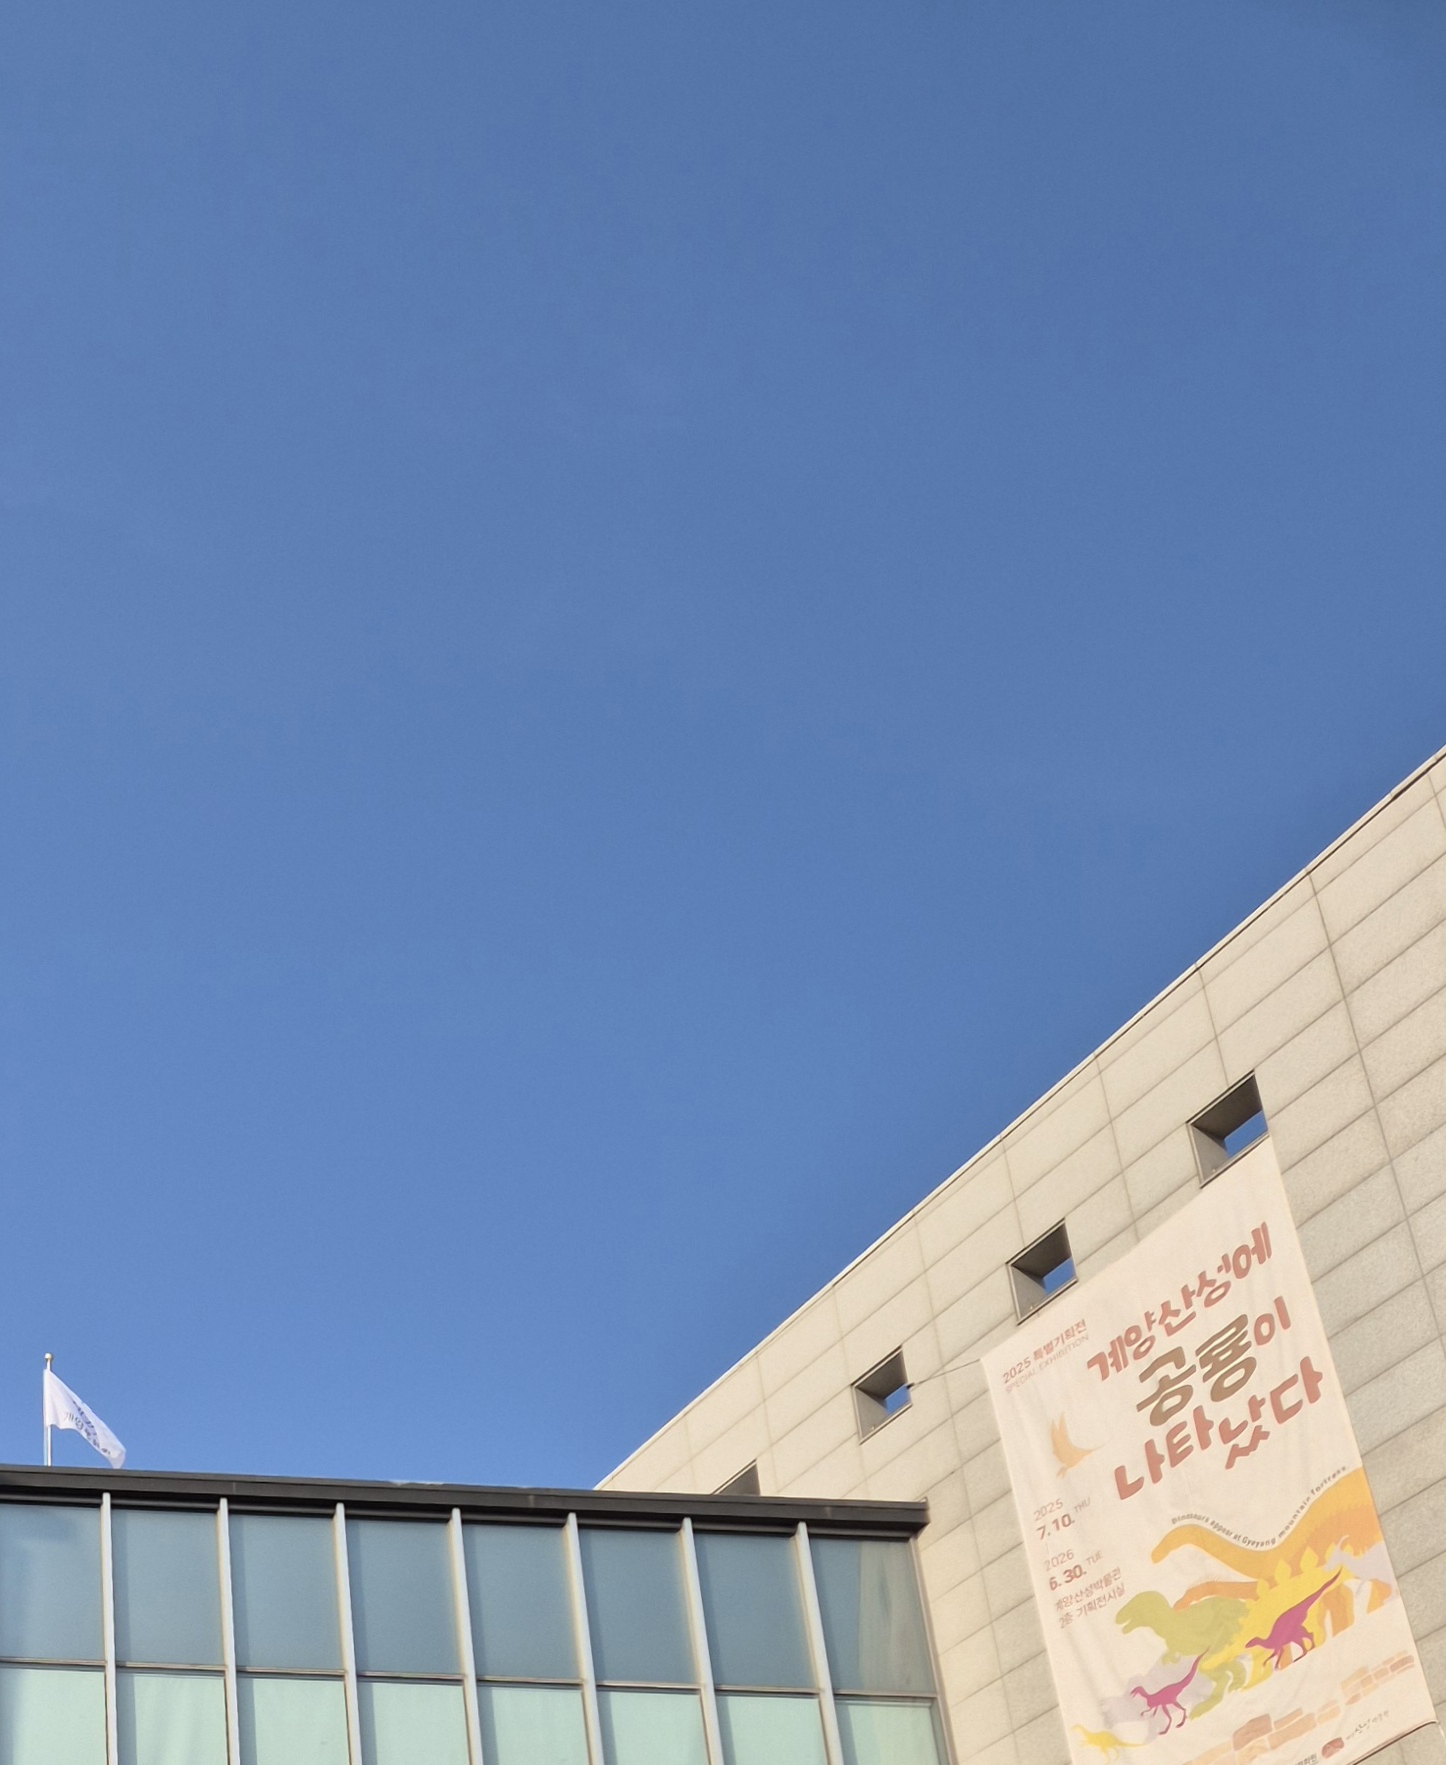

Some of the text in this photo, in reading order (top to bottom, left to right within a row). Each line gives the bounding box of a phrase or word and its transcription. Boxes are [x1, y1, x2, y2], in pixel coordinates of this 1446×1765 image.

[1087, 1221, 1272, 1381] 계양산성에
[1003, 1319, 1087, 1384] 2025 특별기획전
[1005, 1334, 1089, 1394] SPECIAL EXHIBITION
[1136, 1296, 1291, 1426] 공룡이
[1114, 1356, 1323, 1500] 나타났다
[1034, 1498, 1063, 1521] 2025
[1074, 1497, 1091, 1513] THU
[1044, 1549, 1074, 1571] 2026
[1086, 1550, 1103, 1565] TUE
